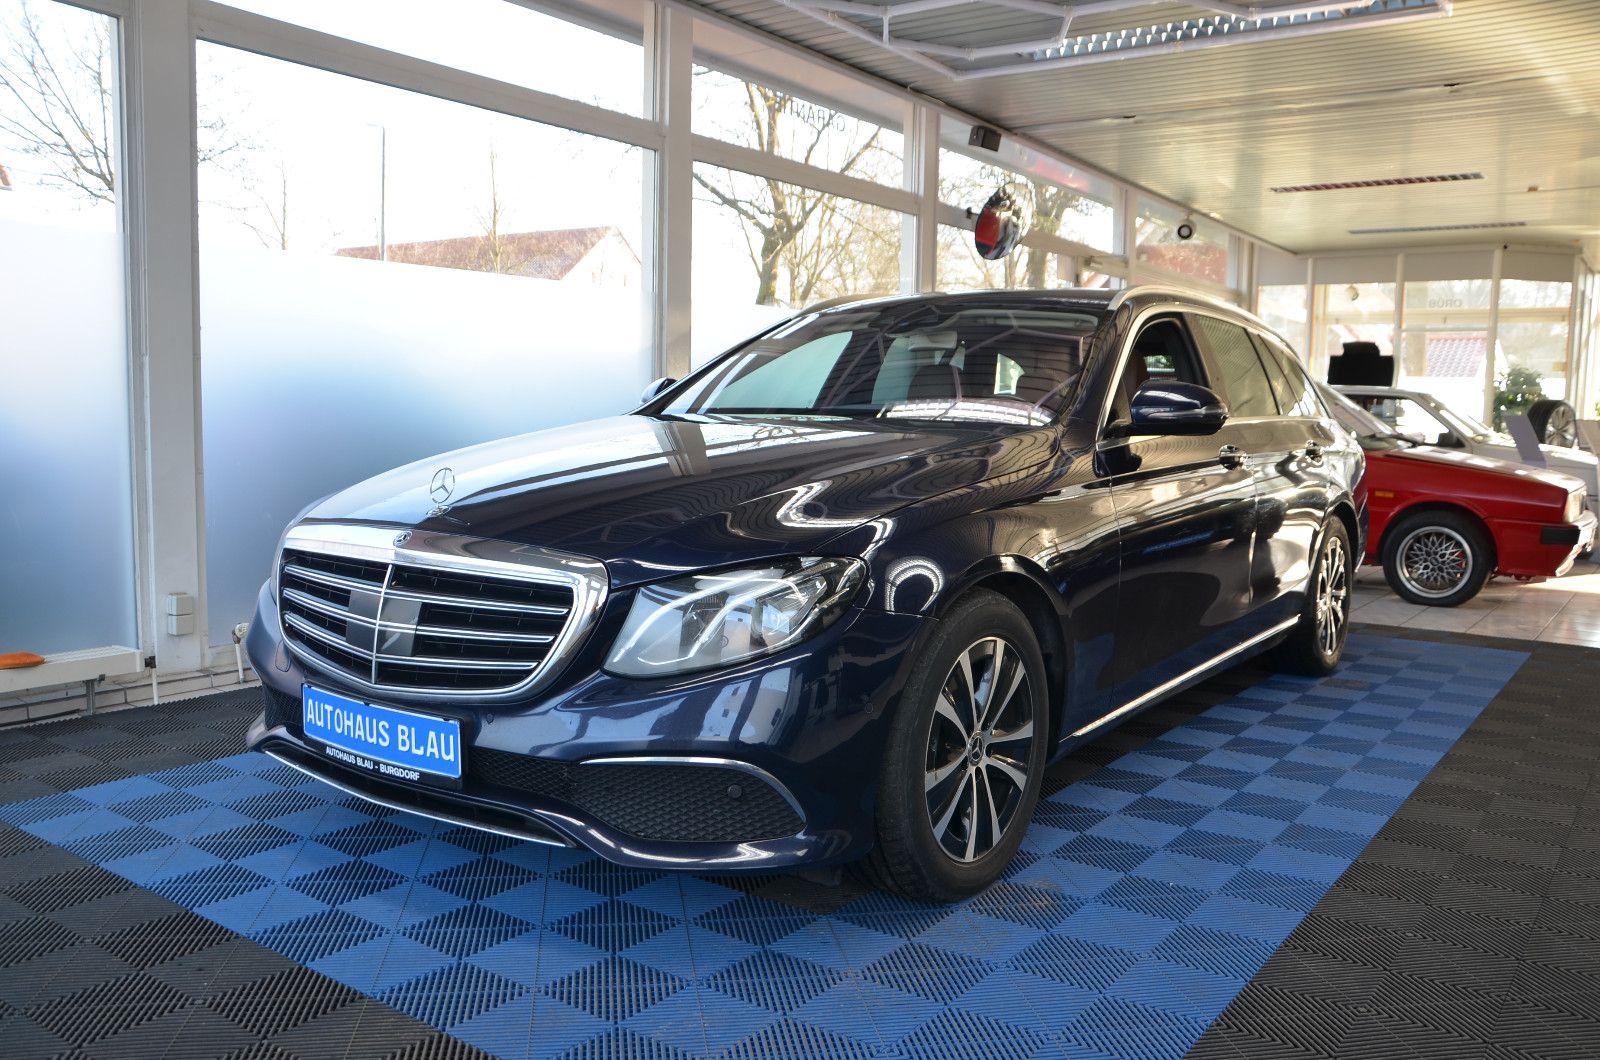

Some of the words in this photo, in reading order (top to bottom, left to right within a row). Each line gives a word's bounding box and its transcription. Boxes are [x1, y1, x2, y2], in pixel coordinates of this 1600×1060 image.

[307, 698, 390, 747] AUTOHAUS
[397, 724, 455, 763] BLAU
[326, 746, 356, 765] AUTOHAUS
[357, 756, 374, 770] BLAU
[380, 764, 420, 781] BURGDORF
